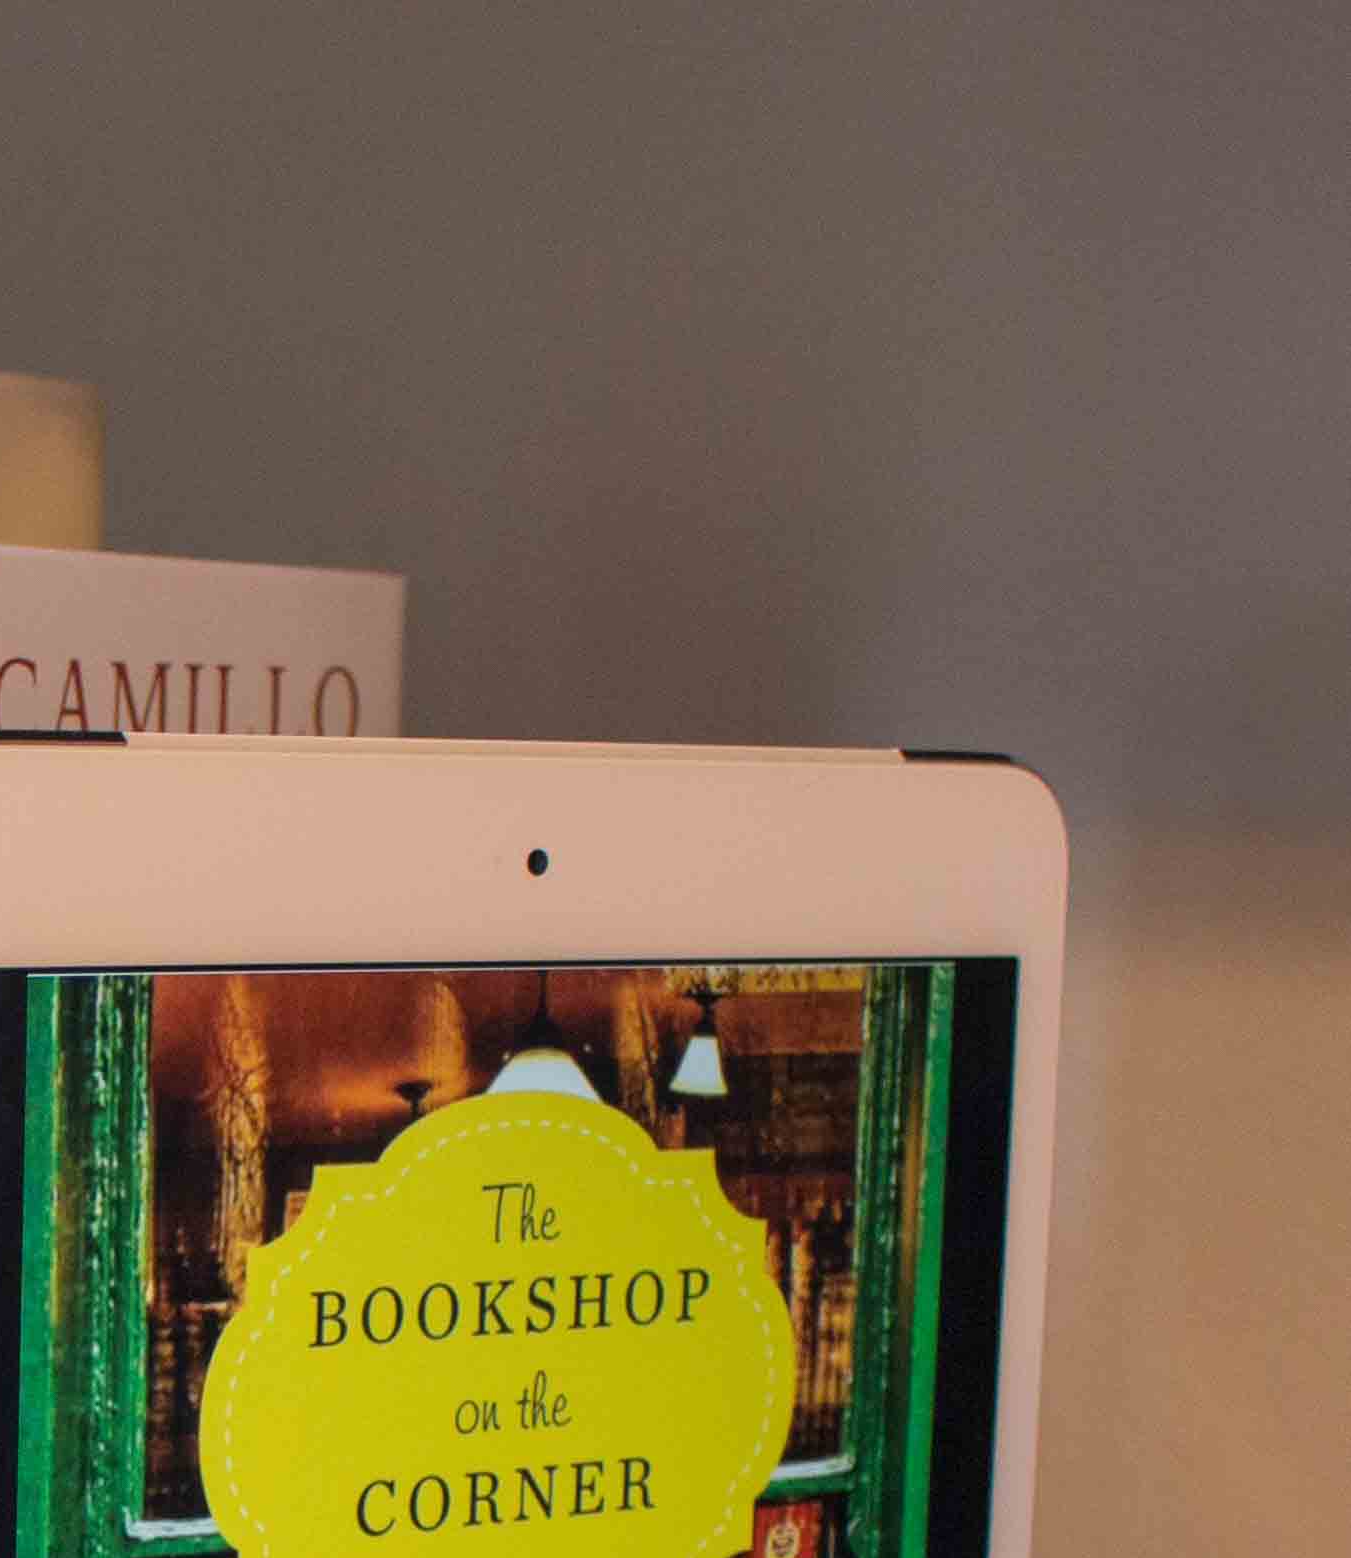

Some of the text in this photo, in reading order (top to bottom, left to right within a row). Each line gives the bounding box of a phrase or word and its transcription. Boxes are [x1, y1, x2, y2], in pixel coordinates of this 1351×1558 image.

[482, 1182, 562, 1244] The
[309, 1266, 711, 1350] BOOKSHOP
[454, 1369, 573, 1435] on the
[355, 1456, 656, 1538] CORNER
